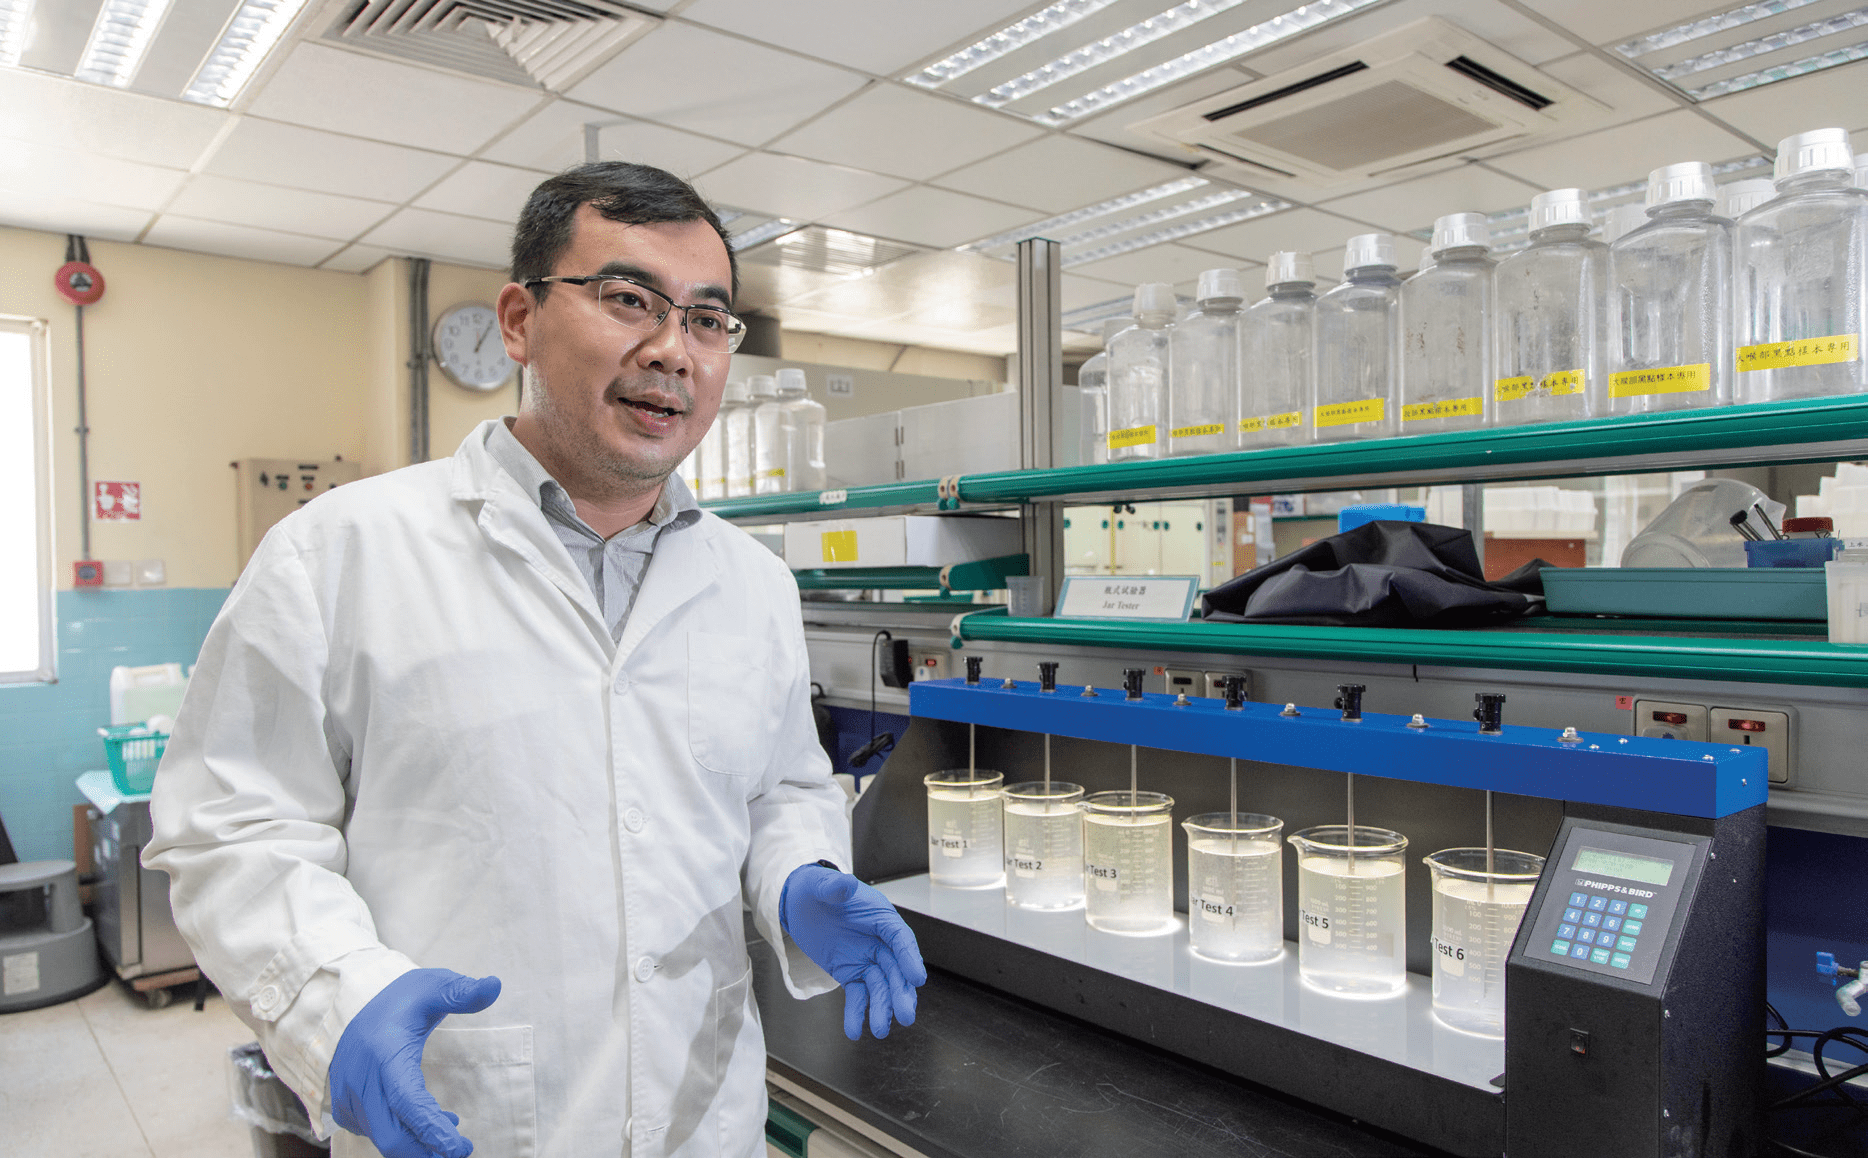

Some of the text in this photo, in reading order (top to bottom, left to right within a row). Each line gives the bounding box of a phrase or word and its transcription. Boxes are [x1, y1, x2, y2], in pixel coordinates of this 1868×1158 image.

[1102, 600, 1140, 610] Jar Tester
[941, 838, 959, 848] Test
[1014, 858, 1032, 870] Test
[1036, 861, 1042, 870] 2
[1090, 864, 1108, 878] Test
[1110, 868, 1117, 879] 3
[1575, 896, 1581, 904] 1
[1594, 899, 1601, 908] 2
[1200, 899, 1222, 915] Test
[1225, 905, 1233, 916] 4
[1614, 903, 1621, 911] 3
[1302, 909, 1329, 929] Test 5
[1569, 911, 1576, 919] 4
[1588, 915, 1596, 923] 5
[1608, 919, 1615, 928] 6
[1563, 927, 1570, 935] 7
[1582, 931, 1590, 940] 8
[1602, 935, 1610, 944] 9
[1434, 937, 1464, 960] Test 6
[1576, 947, 1583, 956] 0
